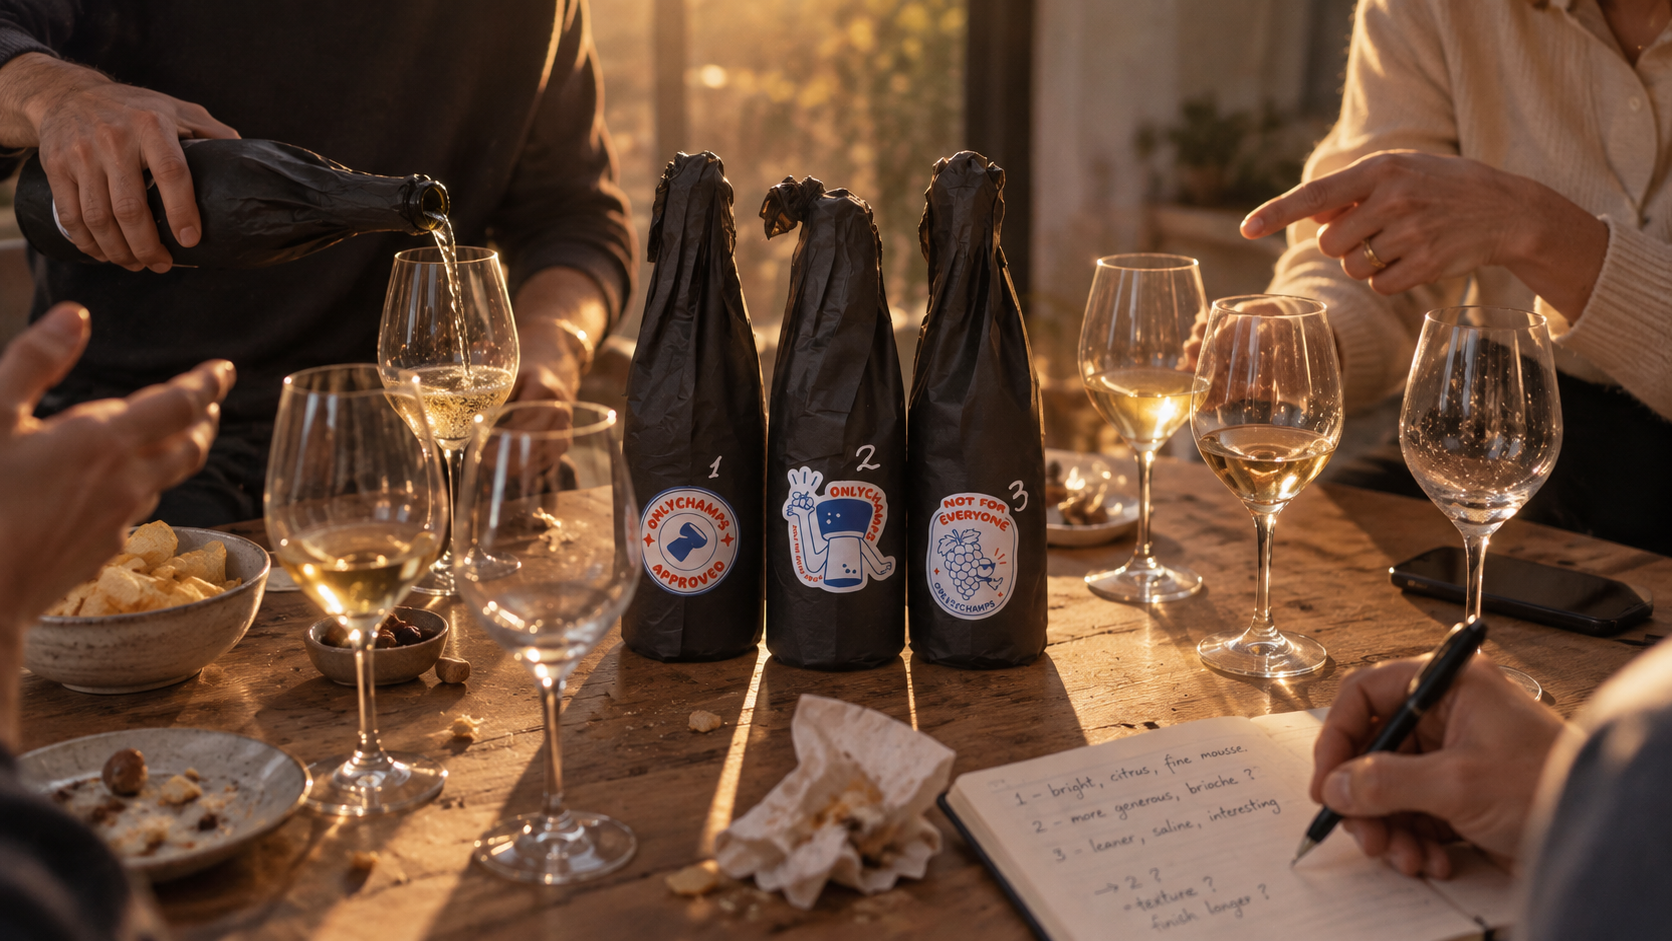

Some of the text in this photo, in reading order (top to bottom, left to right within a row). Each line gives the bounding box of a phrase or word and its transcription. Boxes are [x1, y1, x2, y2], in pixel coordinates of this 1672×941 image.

[708, 455, 722, 479] 1
[855, 444, 881, 472] 2
[943, 496, 1006, 514] NOT FOR
[1008, 480, 1029, 512] 3
[647, 497, 730, 531] ONLYCHAMPS
[830, 486, 884, 542] ONLYCHAMPS
[939, 510, 1010, 532] EVERYONE
[652, 560, 725, 589] APPROVED
[1015, 792, 1027, 807] 1
[1047, 776, 1104, 800] bright,
[1110, 766, 1158, 782] citrus,
[1164, 754, 1192, 774] fine
[1200, 745, 1248, 760] mousse.
[1032, 820, 1047, 834] 2
[1071, 809, 1107, 823] more
[1115, 791, 1180, 820] generous,
[1185, 775, 1239, 795] brioche
[1243, 768, 1255, 781] ?
[1052, 847, 1066, 863] 3
[1088, 838, 1146, 853] leaner,
[1152, 818, 1202, 838] saline,
[1207, 798, 1281, 822] interesting
[1124, 867, 1161, 890] 2 ?
[1202, 876, 1216, 893] ?
[1151, 883, 1270, 931] finish longer ?
